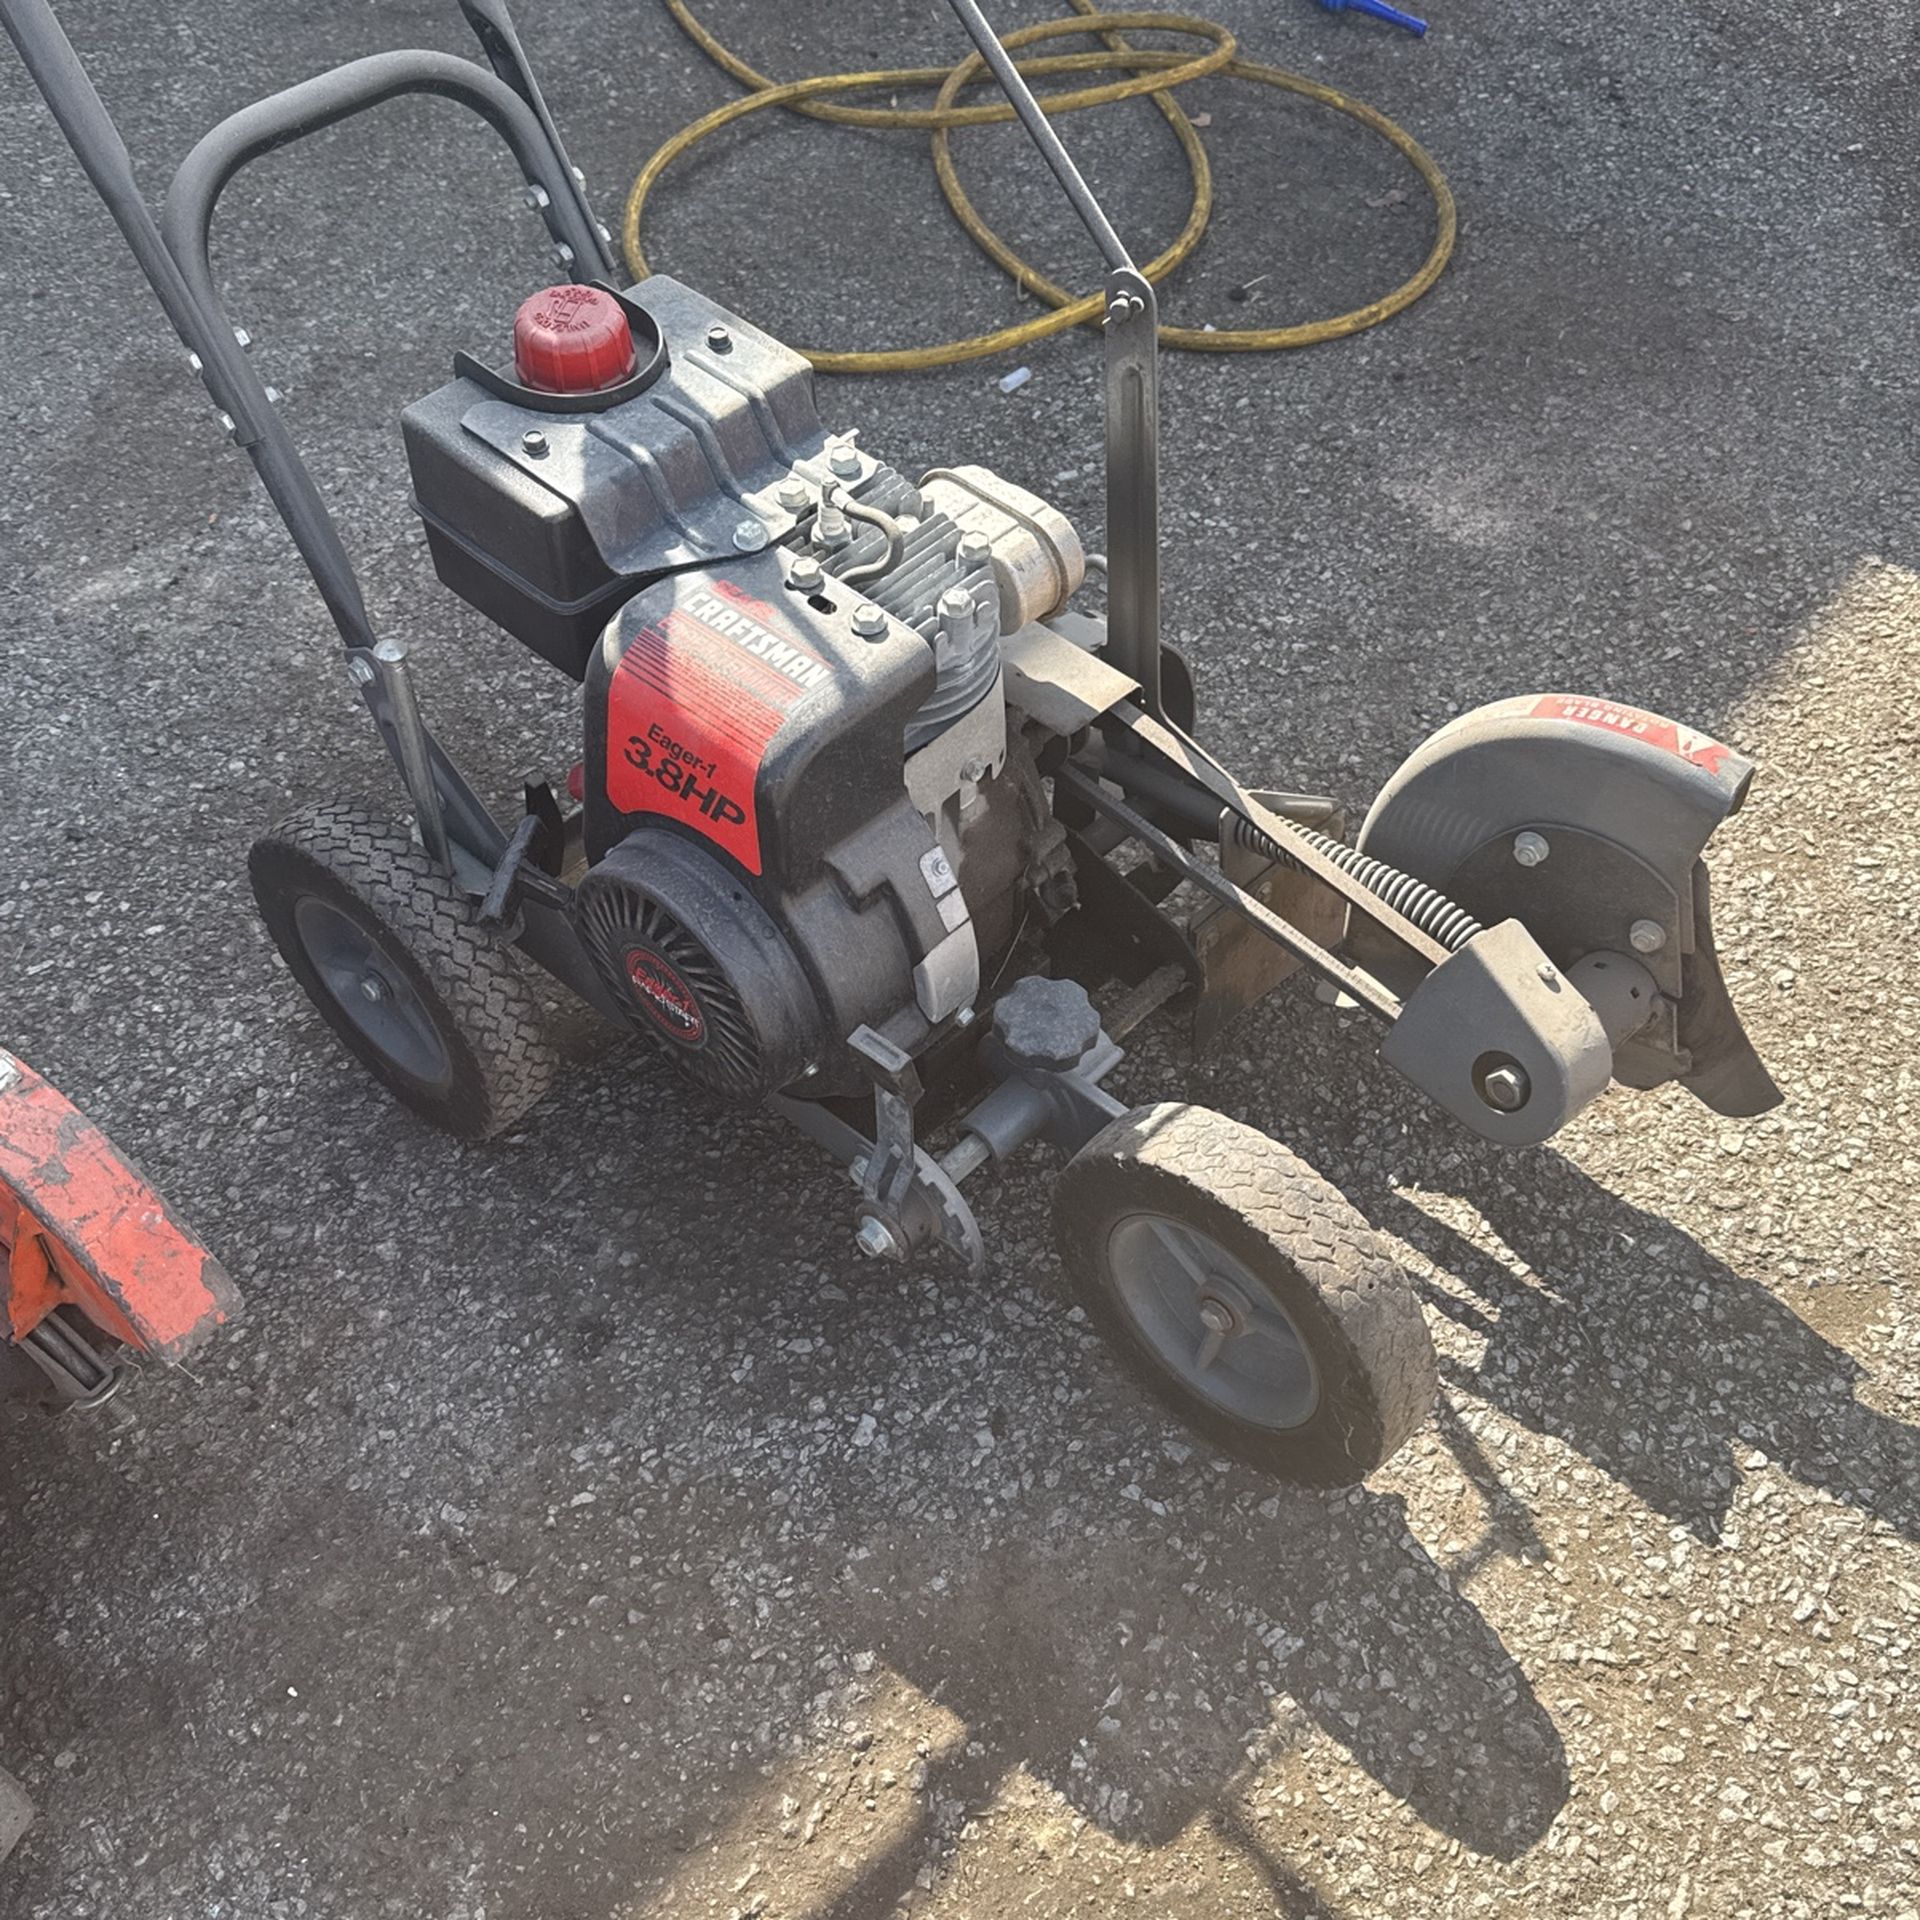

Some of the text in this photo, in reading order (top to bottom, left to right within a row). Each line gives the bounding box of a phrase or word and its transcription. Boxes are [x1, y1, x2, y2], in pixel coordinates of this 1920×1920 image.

[682, 591, 831, 688] CRAFTSMAN
[647, 723, 717, 779] Eager-1
[1562, 705, 1648, 734] DANGER
[623, 735, 746, 825] 3.8HP
